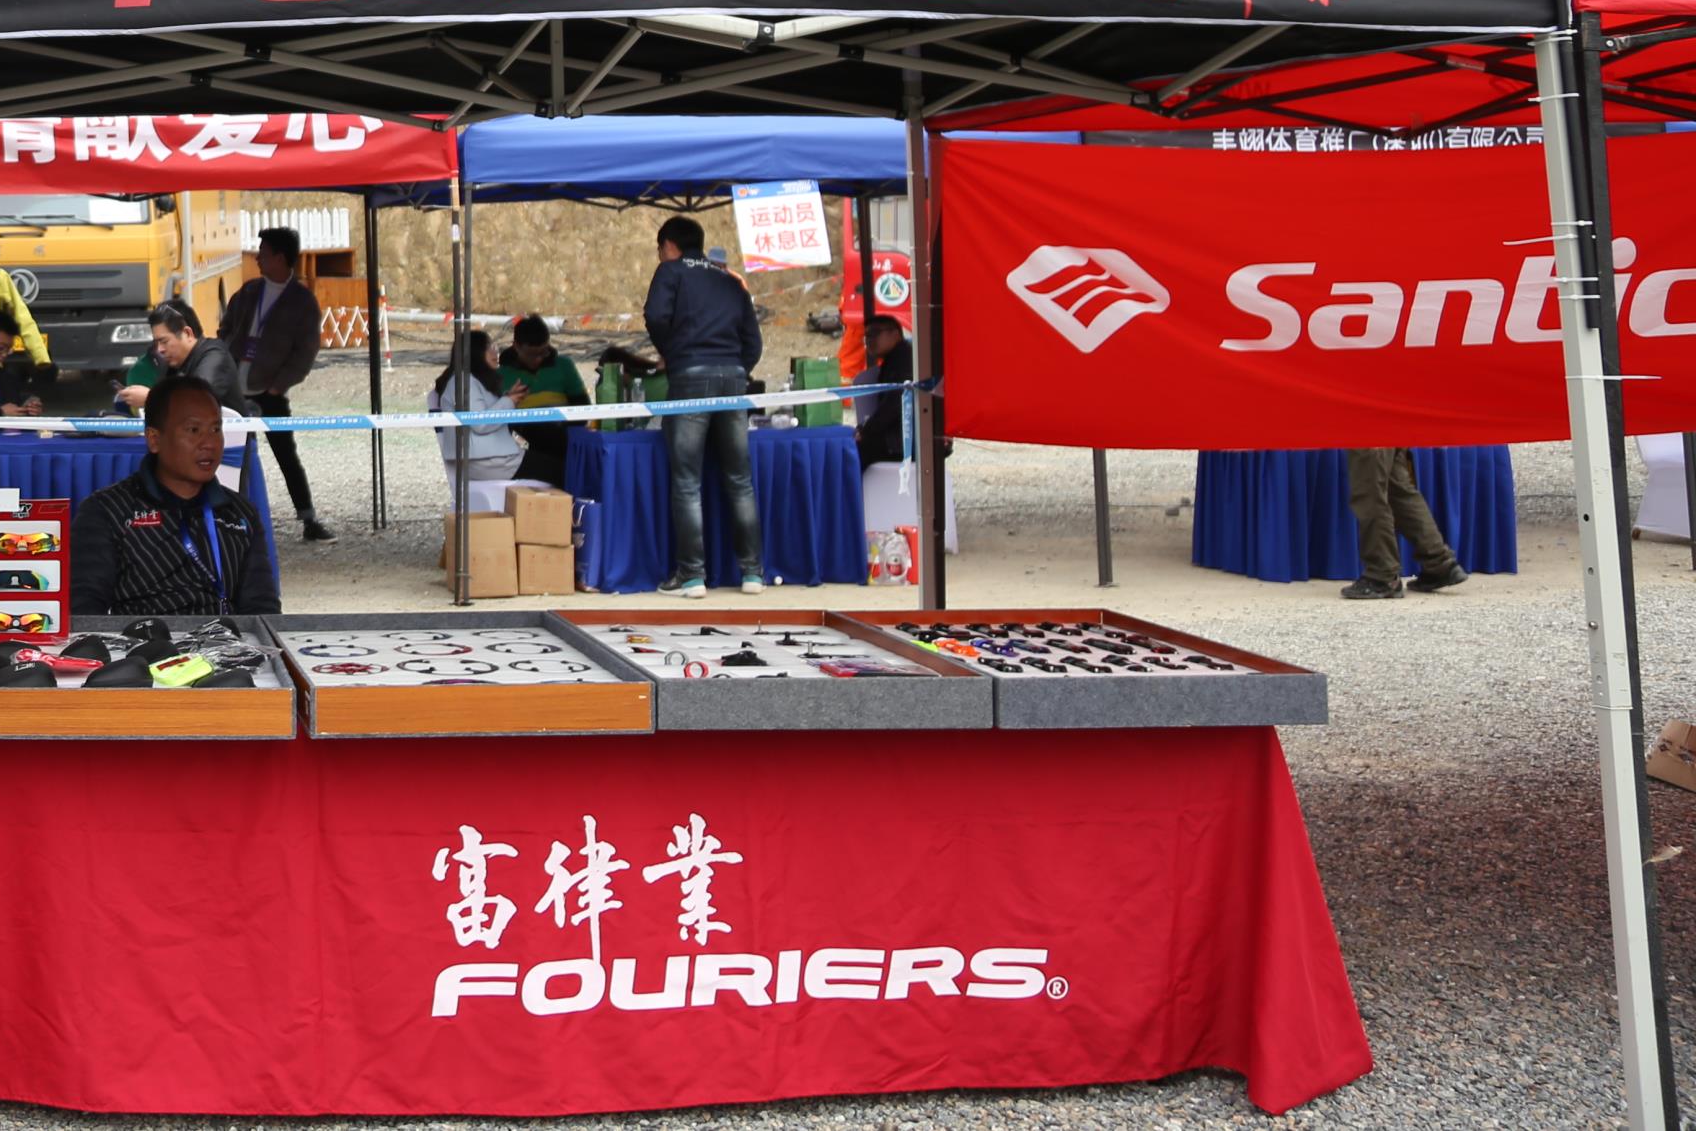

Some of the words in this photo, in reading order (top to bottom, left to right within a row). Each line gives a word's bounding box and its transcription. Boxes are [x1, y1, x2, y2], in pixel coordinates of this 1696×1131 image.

[751, 202, 816, 227] 运动员
[755, 228, 821, 252] 休息区
